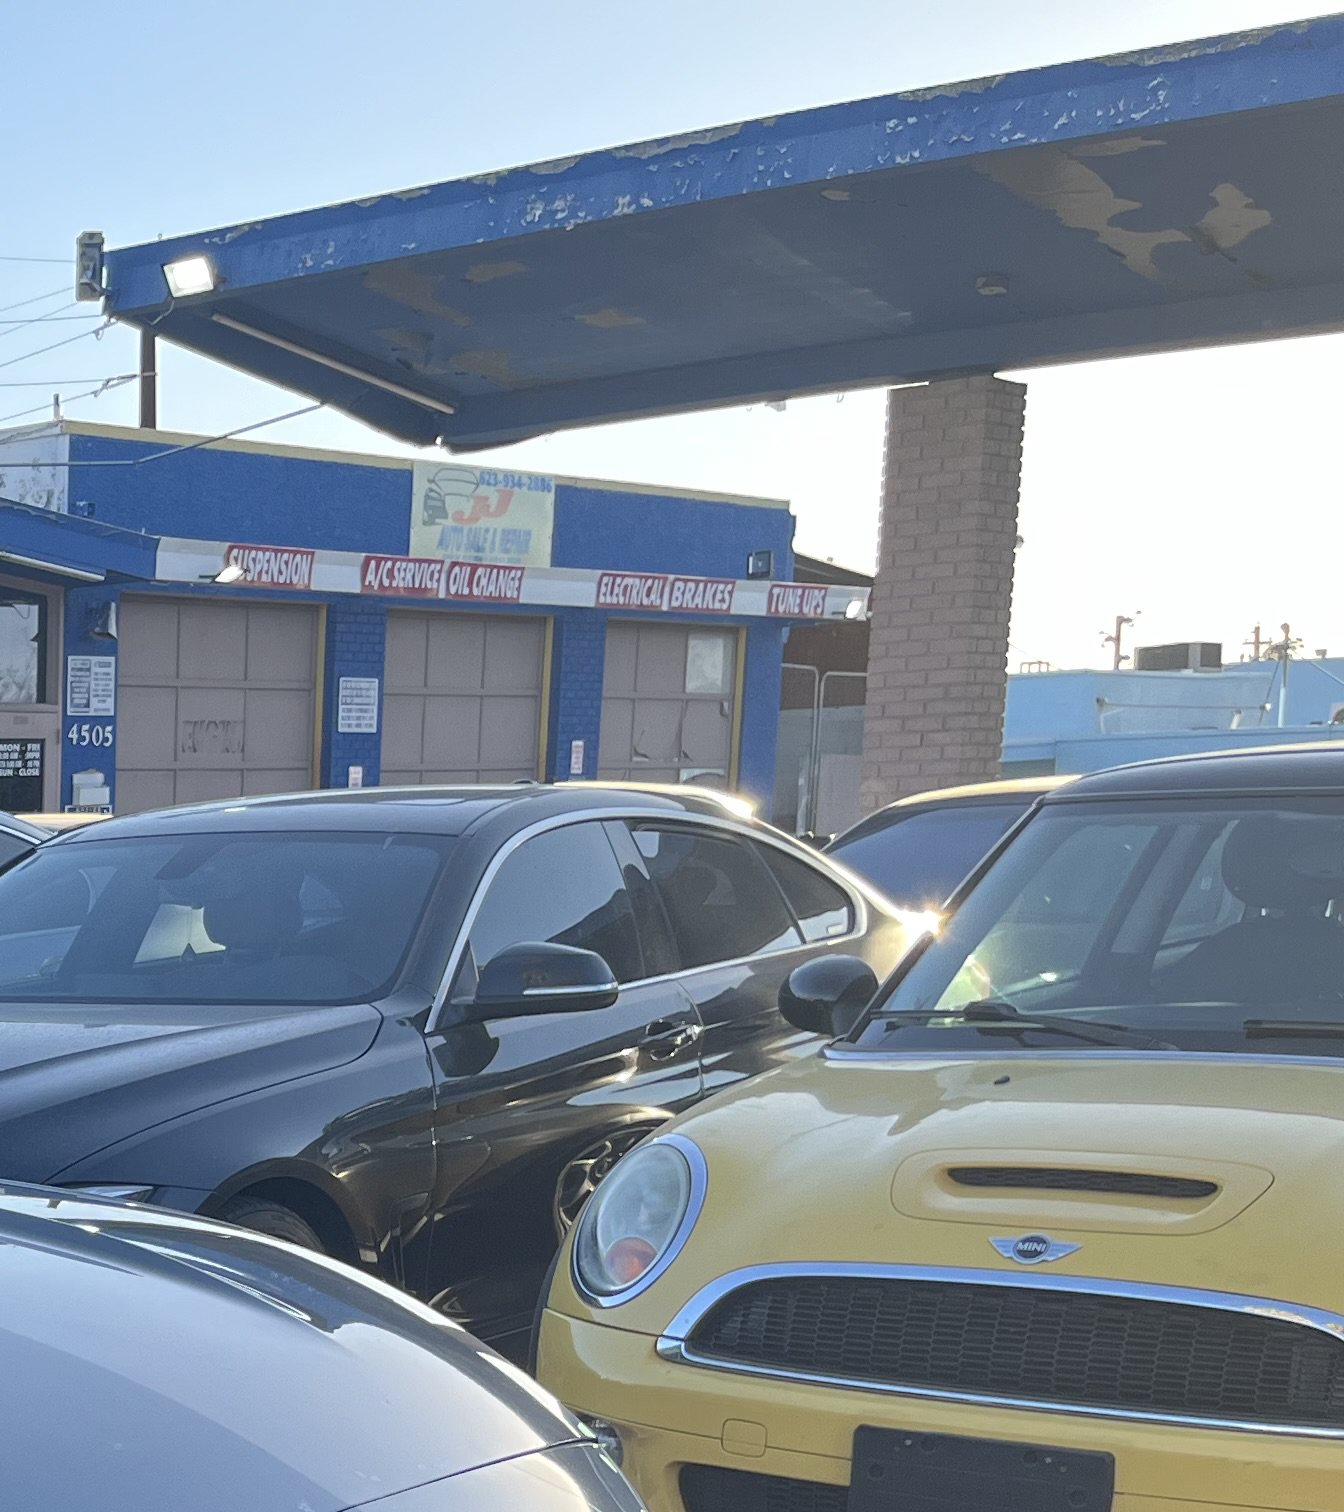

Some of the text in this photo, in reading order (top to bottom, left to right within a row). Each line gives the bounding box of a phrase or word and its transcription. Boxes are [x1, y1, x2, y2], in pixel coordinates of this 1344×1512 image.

[436, 525, 464, 551] AUTO
[228, 548, 311, 585] SUSPENSION
[365, 560, 440, 590] A/C SERVICE
[448, 567, 522, 599] OIL CHANGE
[598, 575, 663, 607] ELECTRICAL
[671, 578, 733, 610] BRAKES
[770, 587, 826, 616] TUNE UPS
[0, 743, 20, 752] MON
[67, 723, 114, 747] 4505
[19, 768, 40, 777] CLOSE
[1016, 1241, 1047, 1253] MINI
